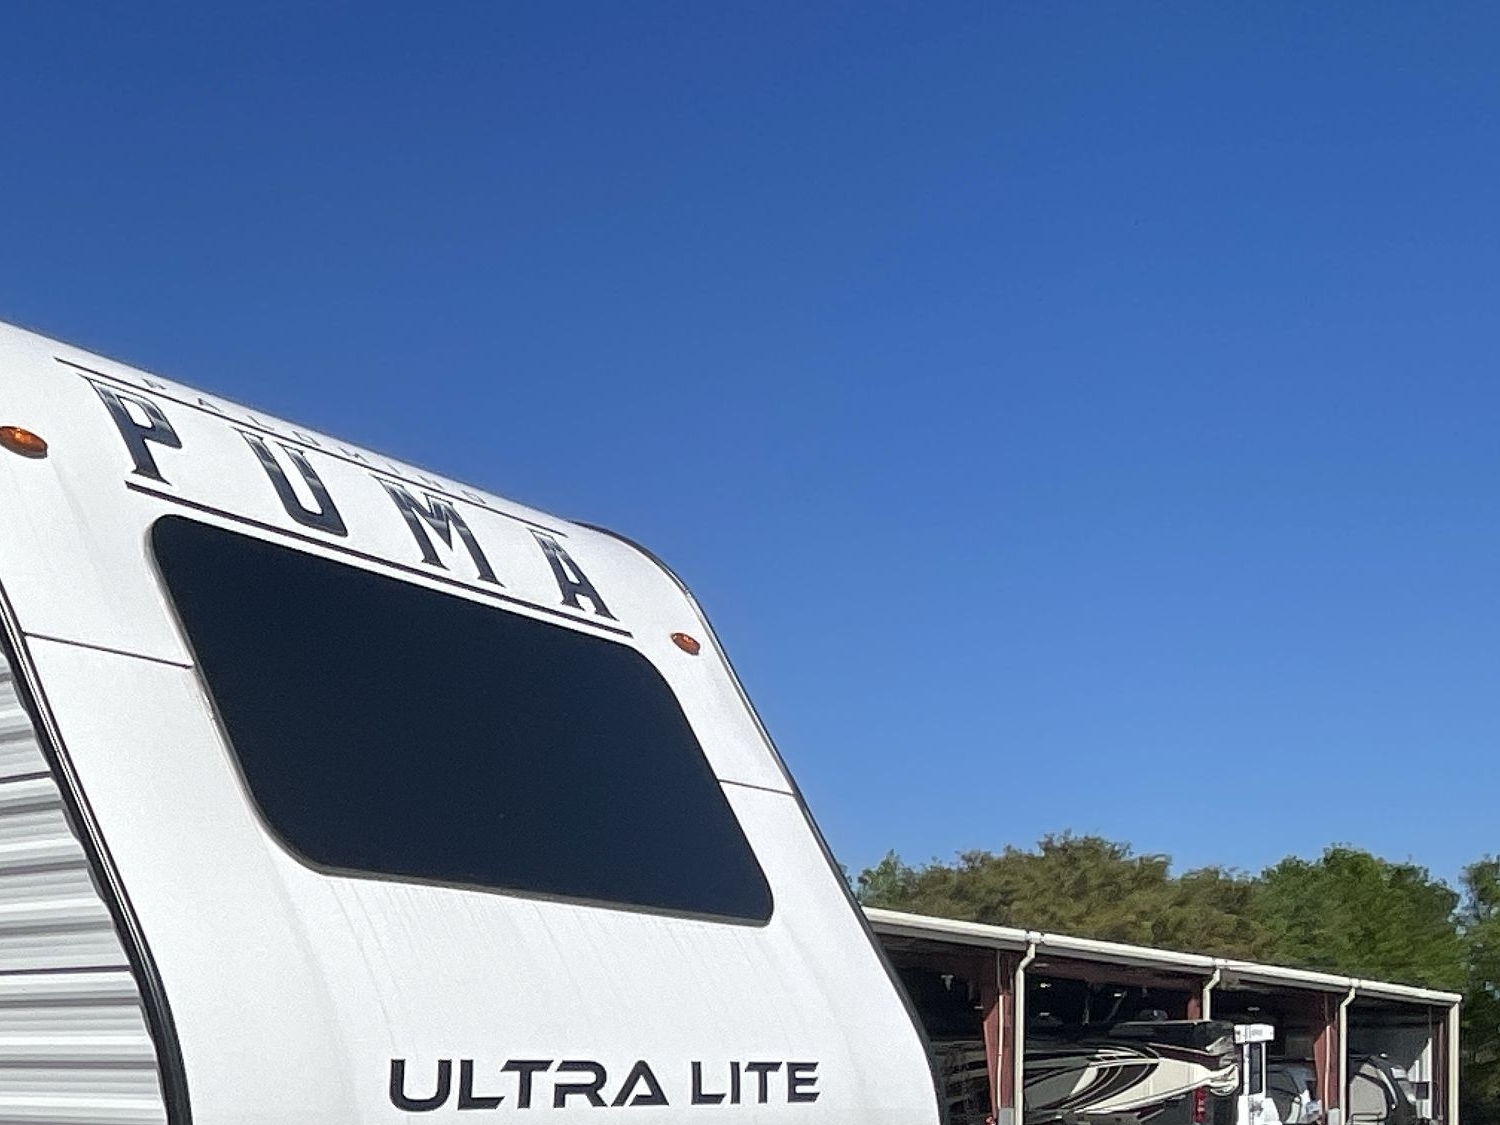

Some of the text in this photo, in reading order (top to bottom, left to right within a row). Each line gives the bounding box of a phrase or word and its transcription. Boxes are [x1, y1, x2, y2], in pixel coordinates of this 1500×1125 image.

[76, 373, 620, 622] PUMA
[389, 1059, 820, 1112] ULTRA LITE
